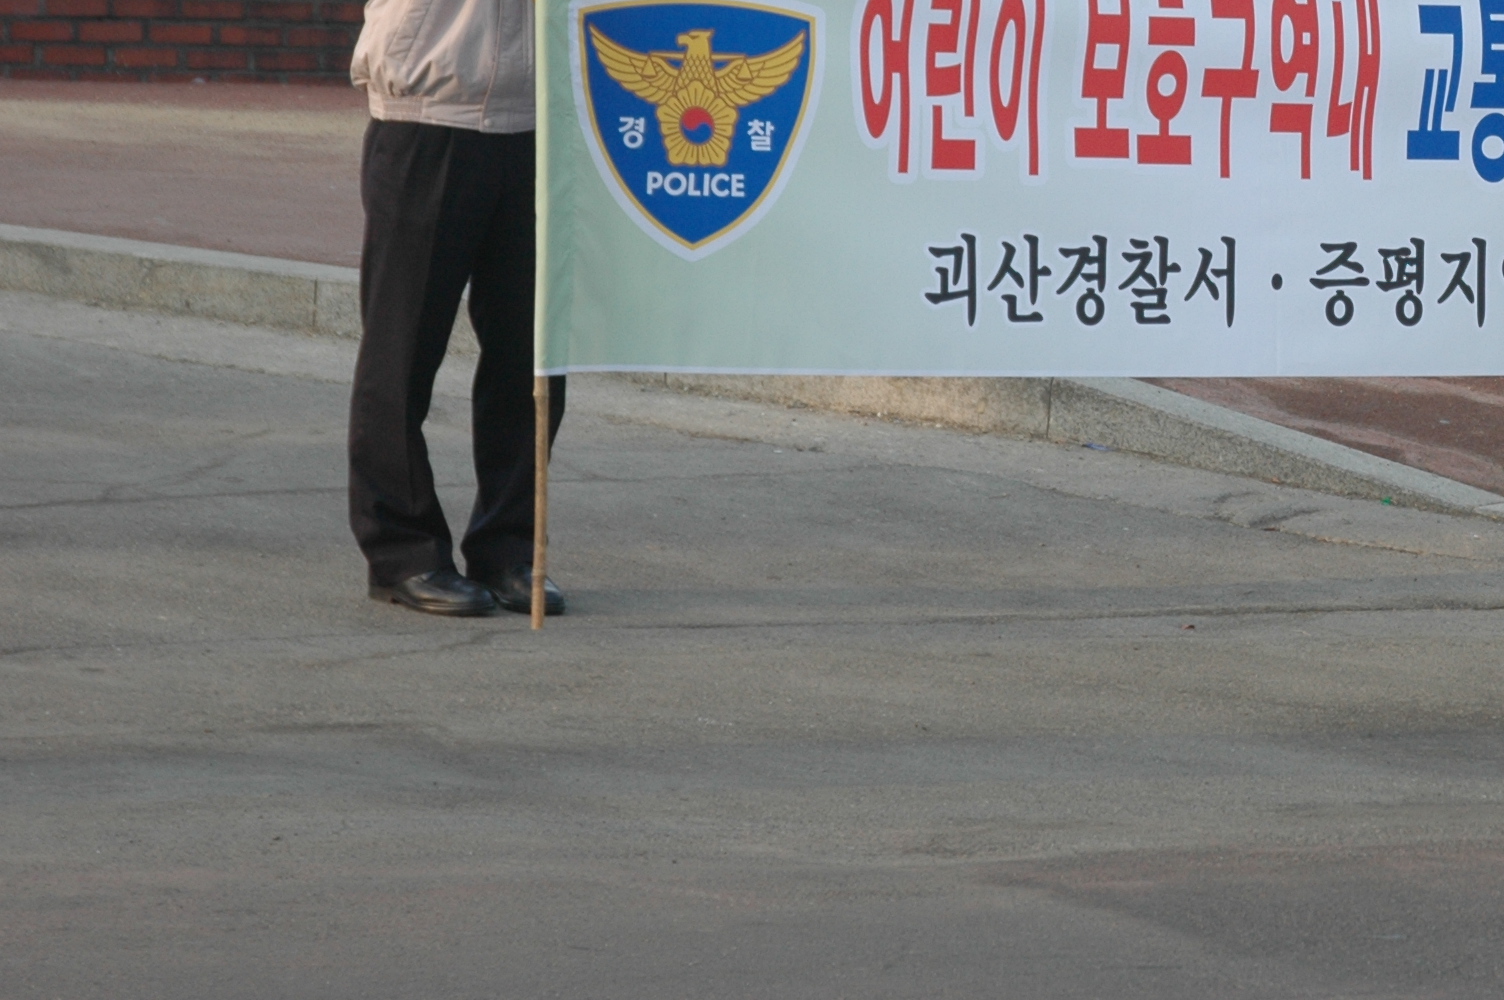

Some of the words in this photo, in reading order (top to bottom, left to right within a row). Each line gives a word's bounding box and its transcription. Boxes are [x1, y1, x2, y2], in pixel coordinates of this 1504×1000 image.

[619, 117, 646, 148] 경
[747, 119, 775, 151] 찰
[646, 171, 746, 198] POLICE
[924, 232, 1237, 328] 괴산경찰서
